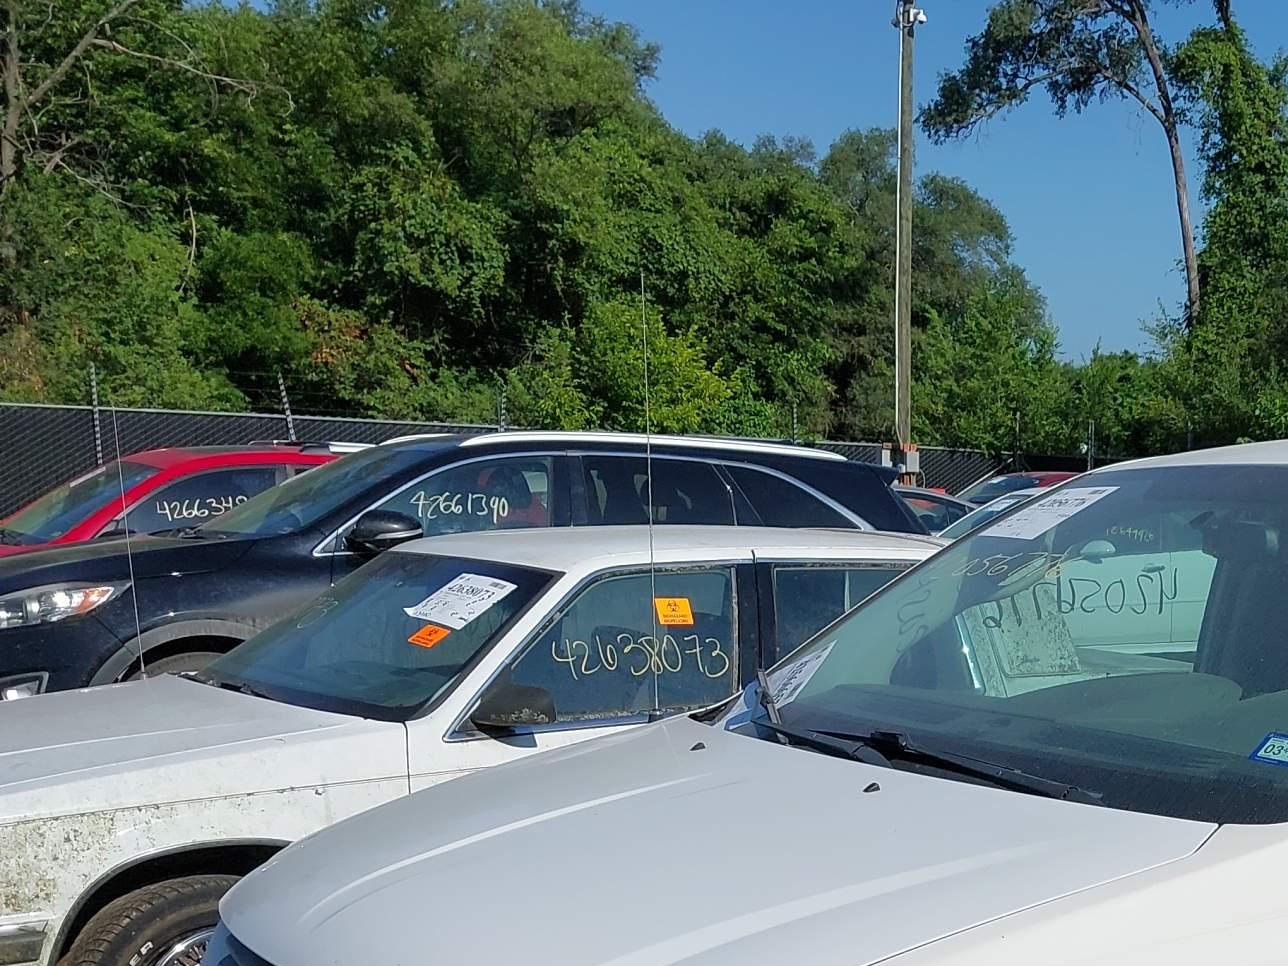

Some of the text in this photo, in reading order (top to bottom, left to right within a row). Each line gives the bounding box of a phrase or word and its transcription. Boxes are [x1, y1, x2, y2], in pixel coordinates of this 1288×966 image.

[409, 490, 508, 525] 42661390
[551, 632, 730, 681] 42638073
[1263, 744, 1285, 756] 03
